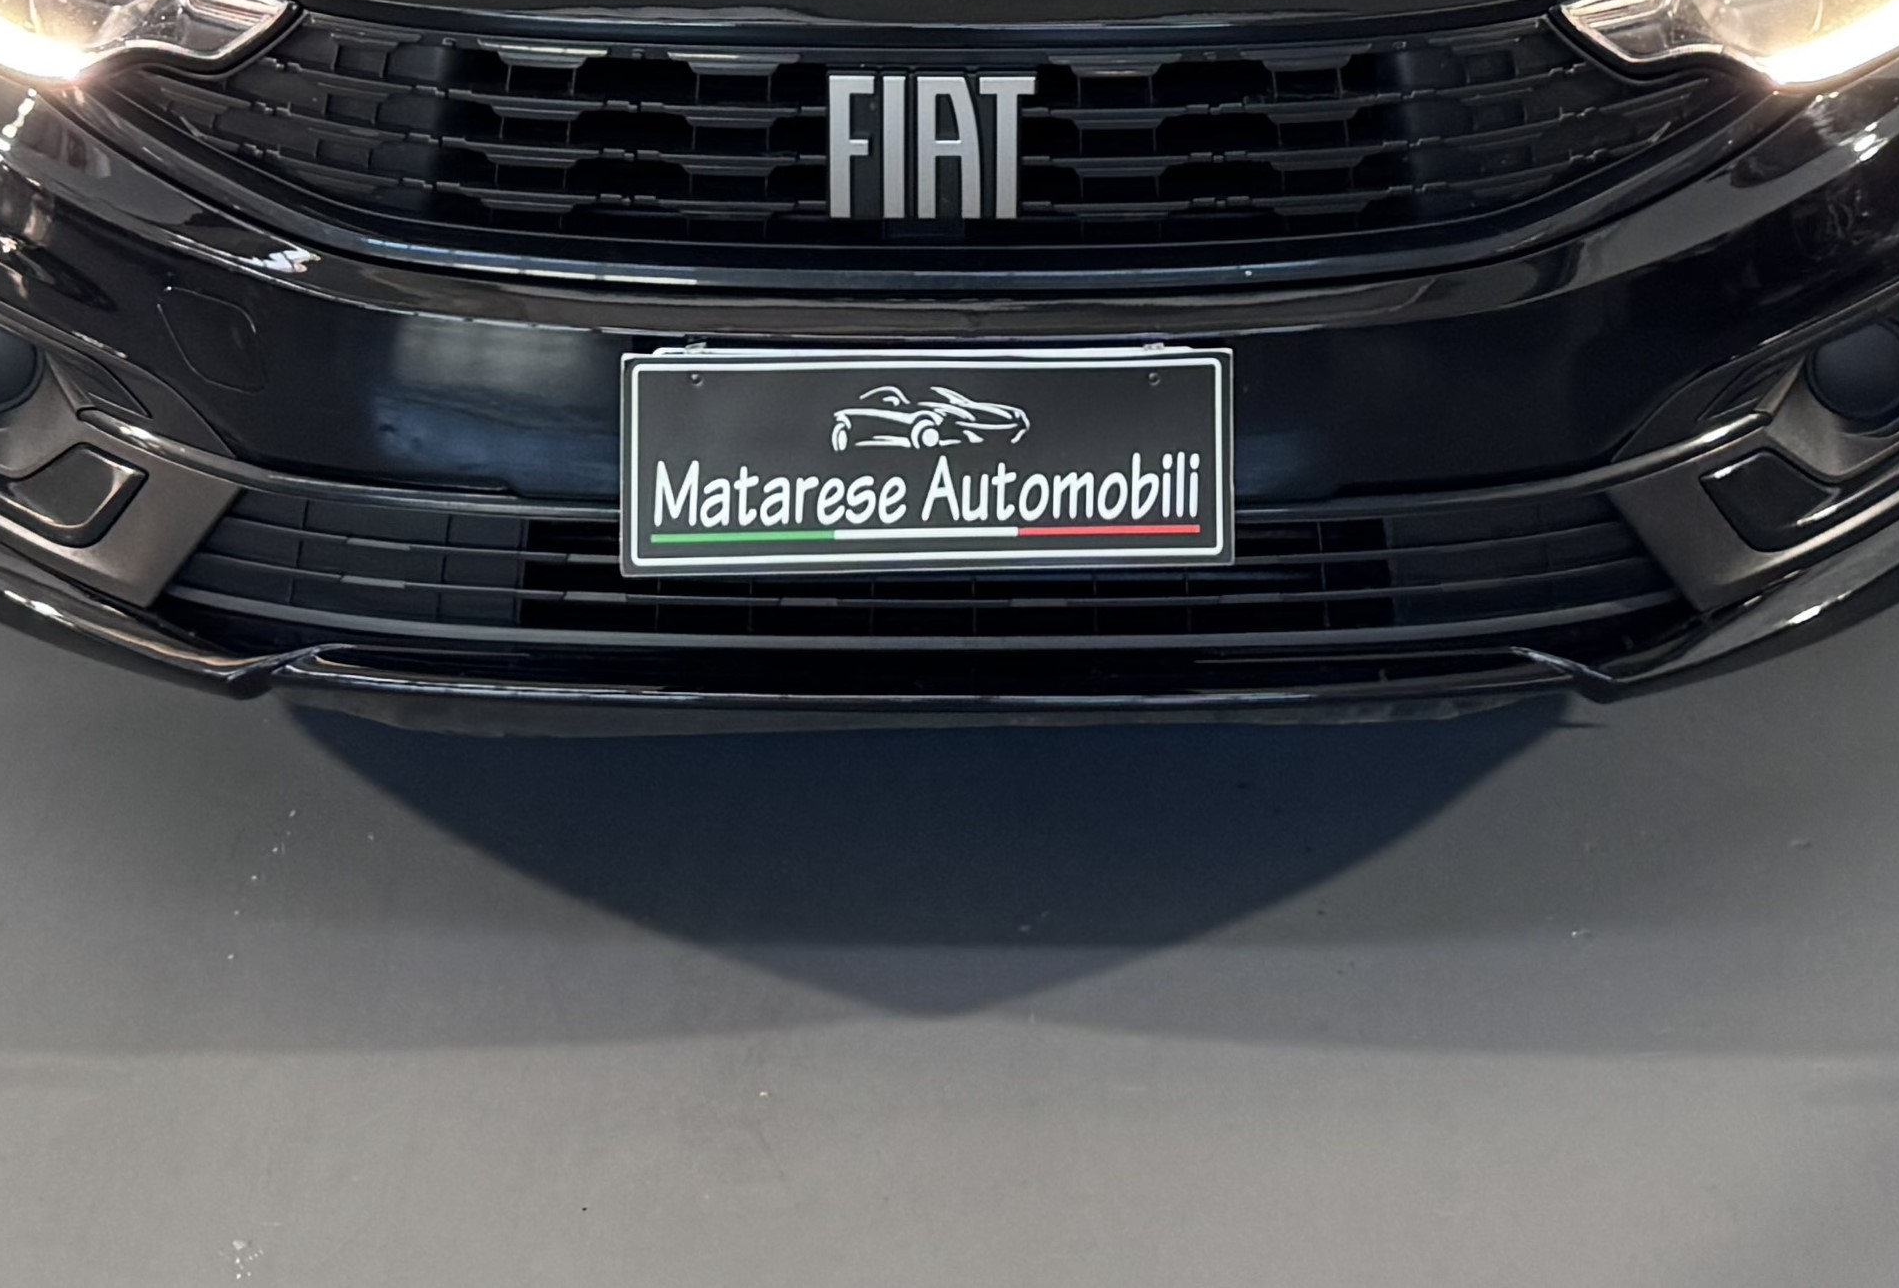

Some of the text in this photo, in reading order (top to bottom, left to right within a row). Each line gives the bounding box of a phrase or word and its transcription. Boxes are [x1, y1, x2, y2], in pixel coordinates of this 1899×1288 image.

[828, 75, 1036, 219] FIAT
[653, 451, 1201, 528] Matarese Automobili
